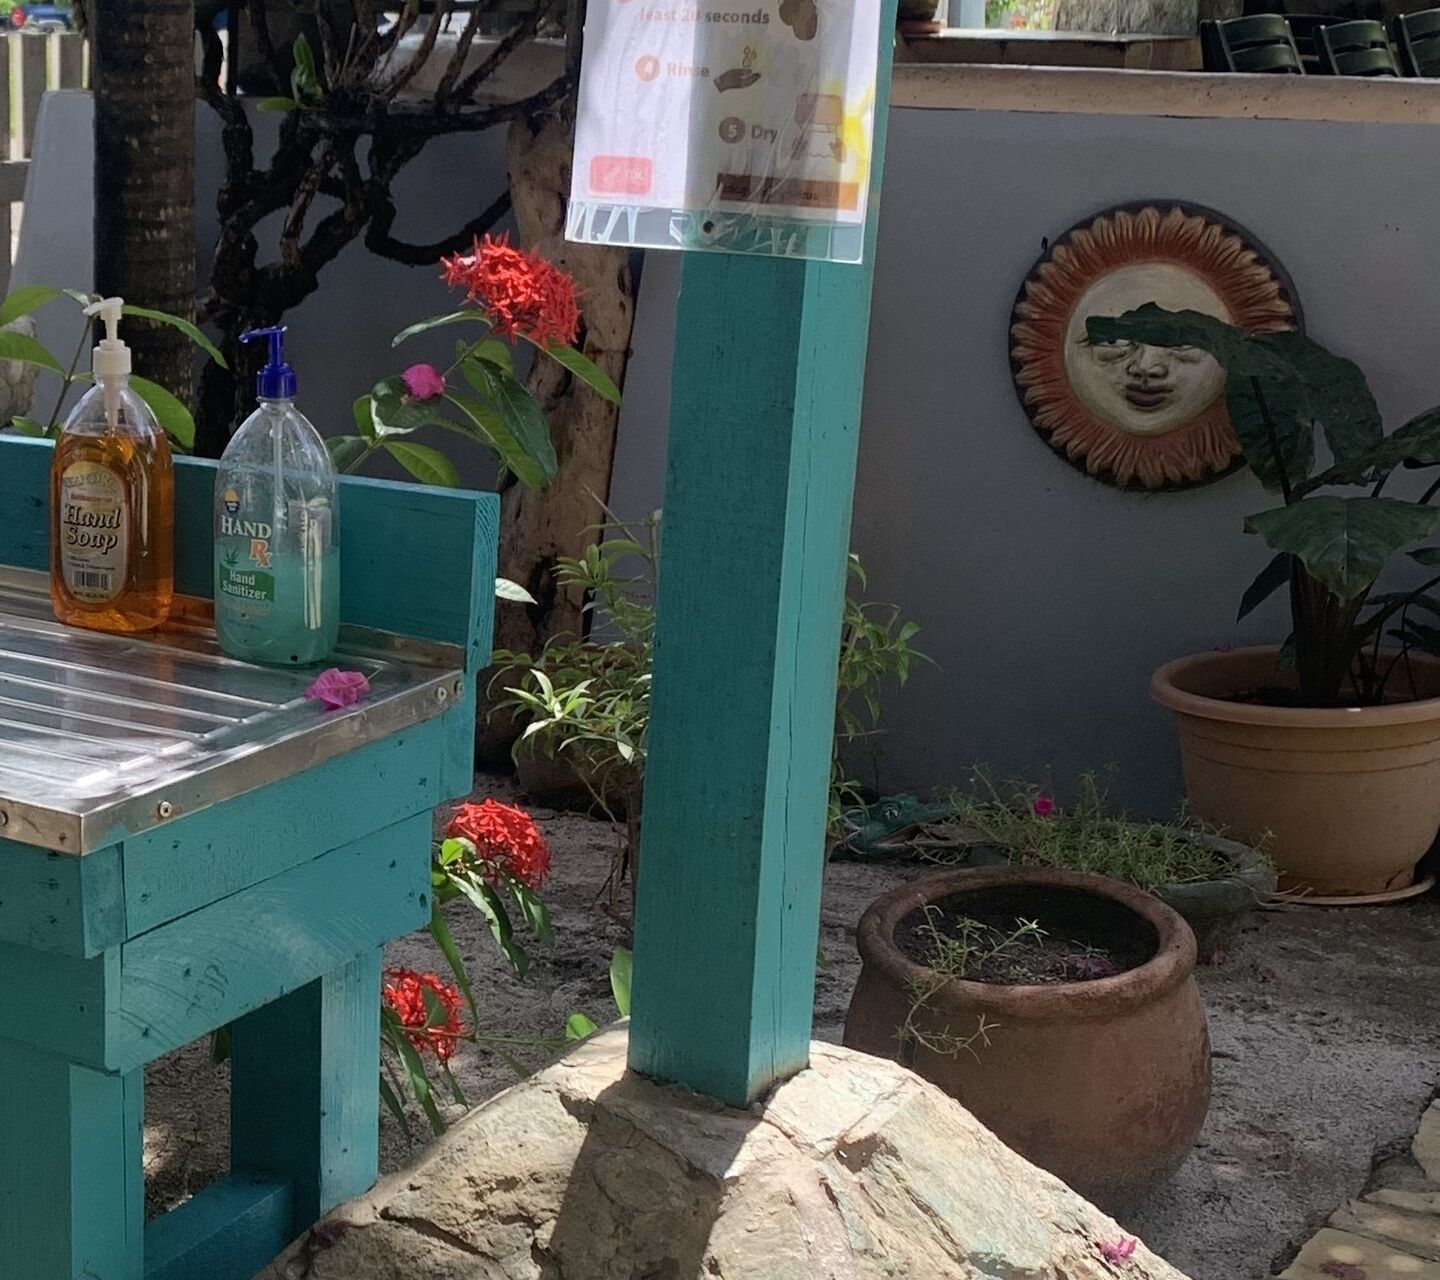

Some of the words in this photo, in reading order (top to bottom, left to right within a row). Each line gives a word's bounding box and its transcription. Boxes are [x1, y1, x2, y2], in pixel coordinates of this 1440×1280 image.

[705, 7, 770, 24] seconds
[667, 62, 710, 77] Rinse
[751, 124, 778, 143] Dry
[64, 504, 121, 529] Hand
[220, 515, 272, 539] HAND
[66, 526, 118, 555] Soap
[230, 570, 256, 586] Hand
[222, 581, 267, 601] Sanitizer
